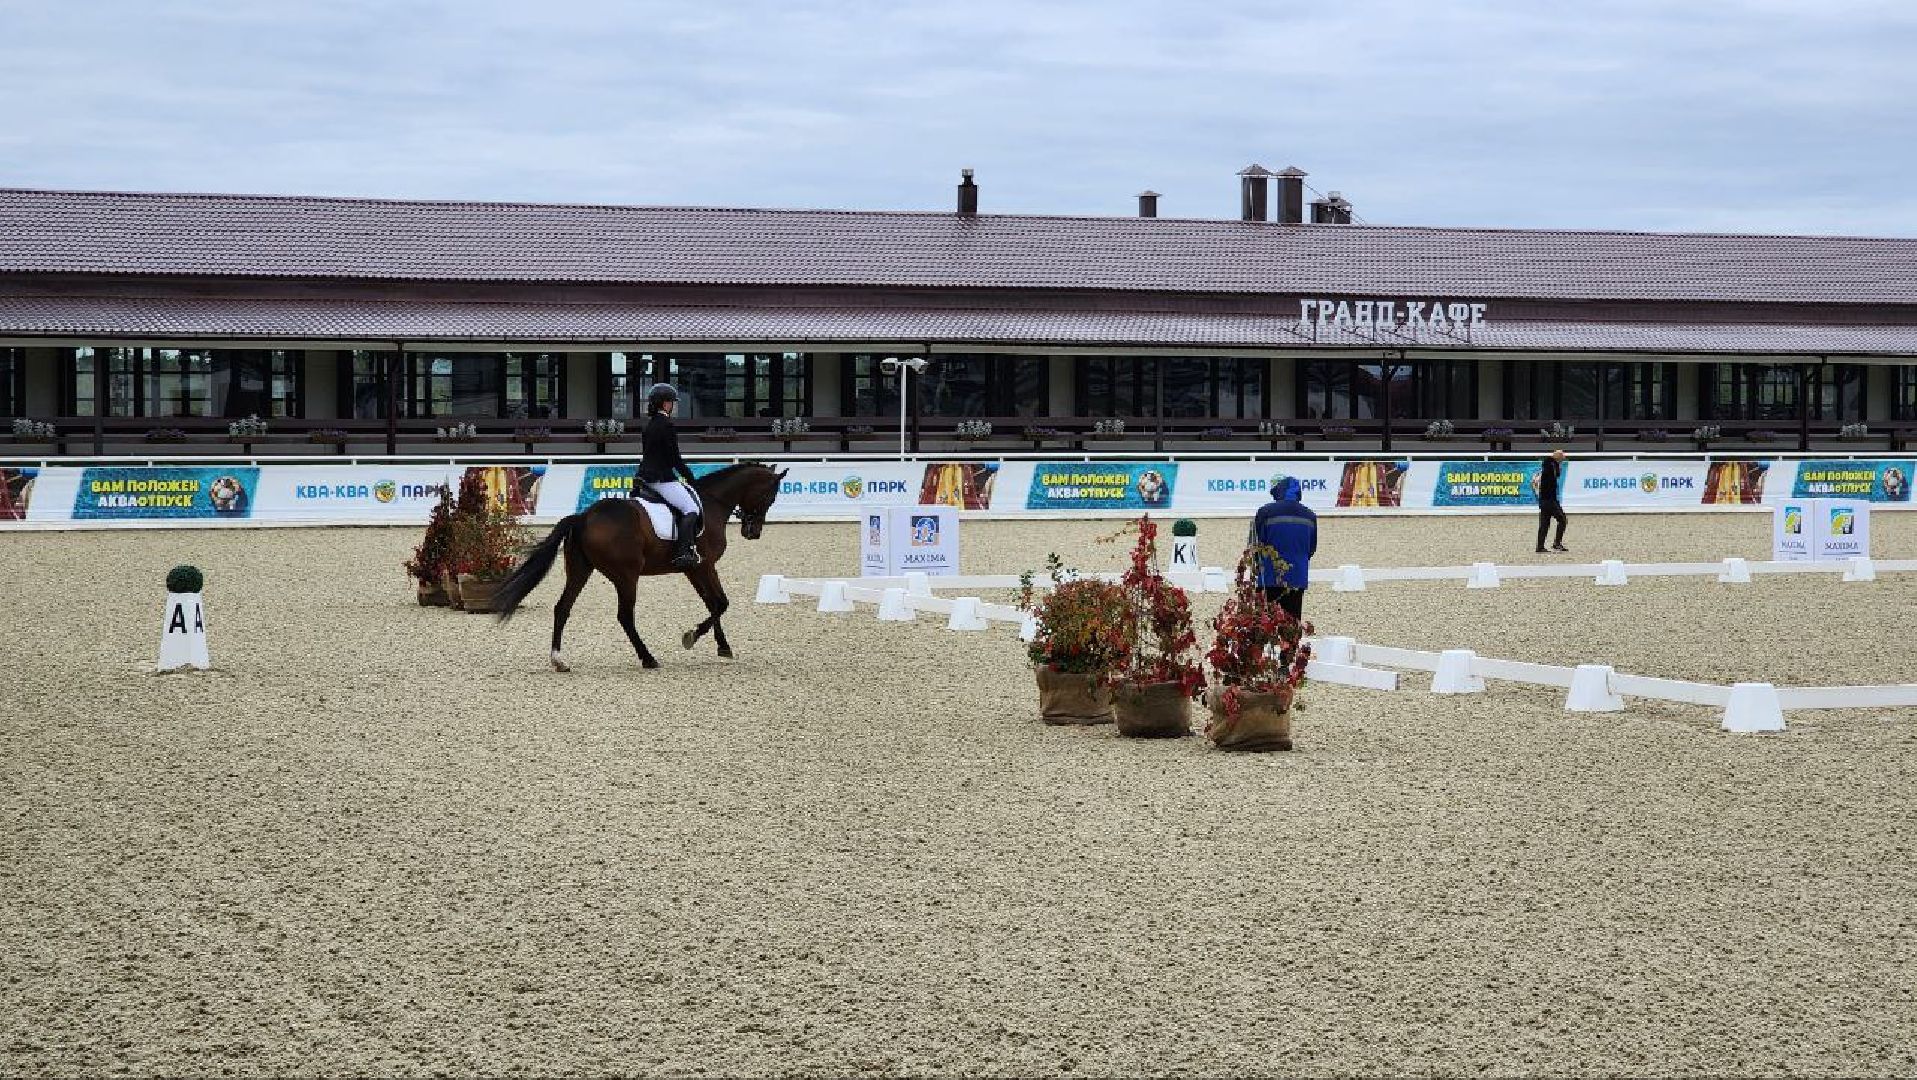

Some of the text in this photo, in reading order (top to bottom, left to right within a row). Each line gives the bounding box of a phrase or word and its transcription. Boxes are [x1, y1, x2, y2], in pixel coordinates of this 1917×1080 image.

[1300, 299, 1486, 328] ГРАНД-КАФЕ
[1042, 474, 1068, 485] ВАМ
[1298, 480, 1327, 491] АРК
[1661, 477, 1693, 489] ПАРК
[92, 480, 124, 492] ВАМ
[867, 481, 907, 493] ПАРК
[97, 495, 193, 507] АКВАОТПУСК
[1174, 543, 1186, 564] K
[168, 602, 187, 633] A
[194, 602, 204, 633] A
